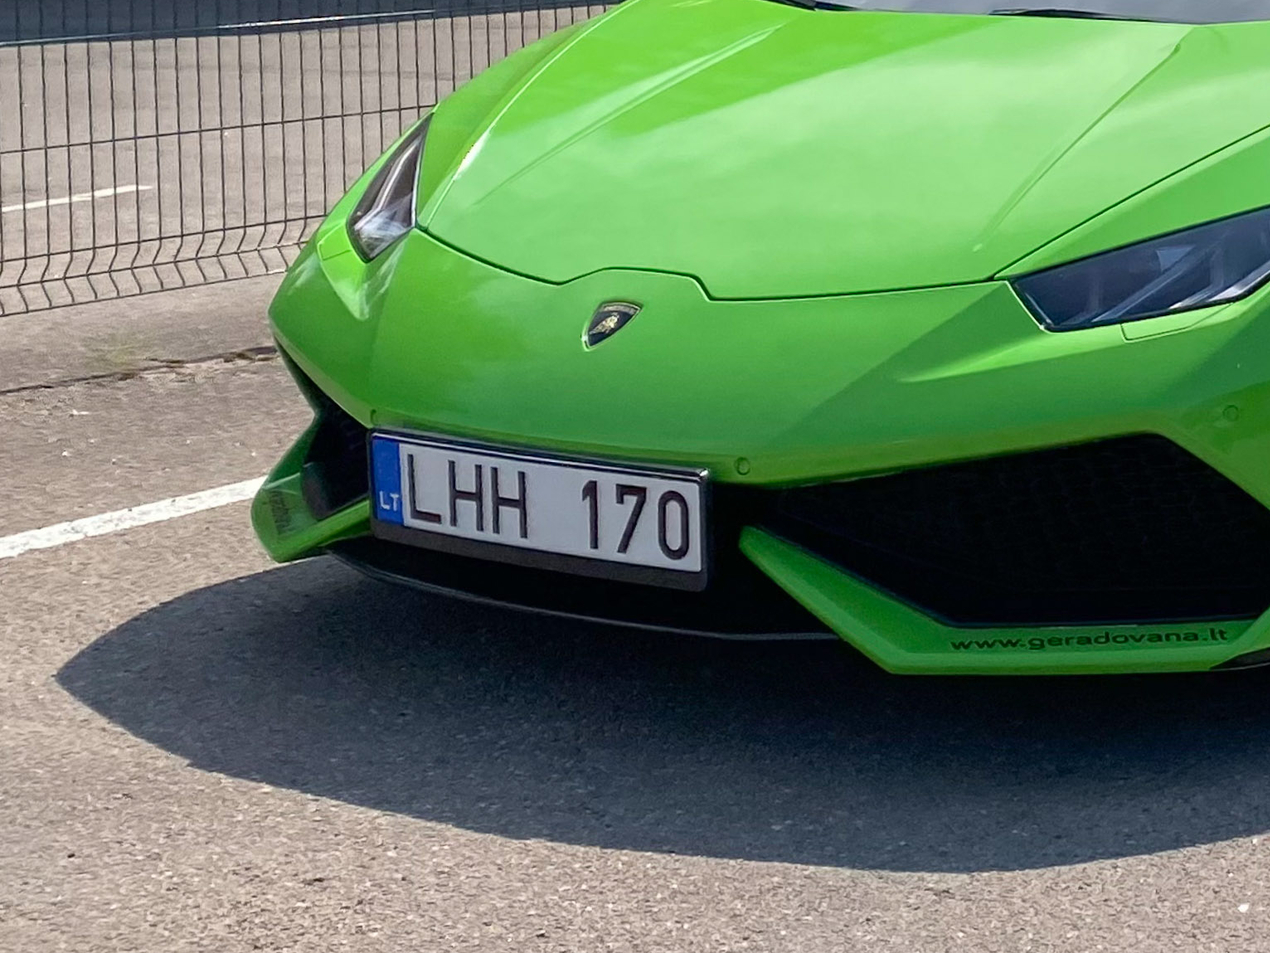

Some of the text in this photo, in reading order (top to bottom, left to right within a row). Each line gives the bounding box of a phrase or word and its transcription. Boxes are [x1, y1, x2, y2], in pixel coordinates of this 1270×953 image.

[379, 490, 400, 512] LT
[407, 453, 690, 561] LHH 170
[950, 628, 1228, 650] www.geradovana.lt
